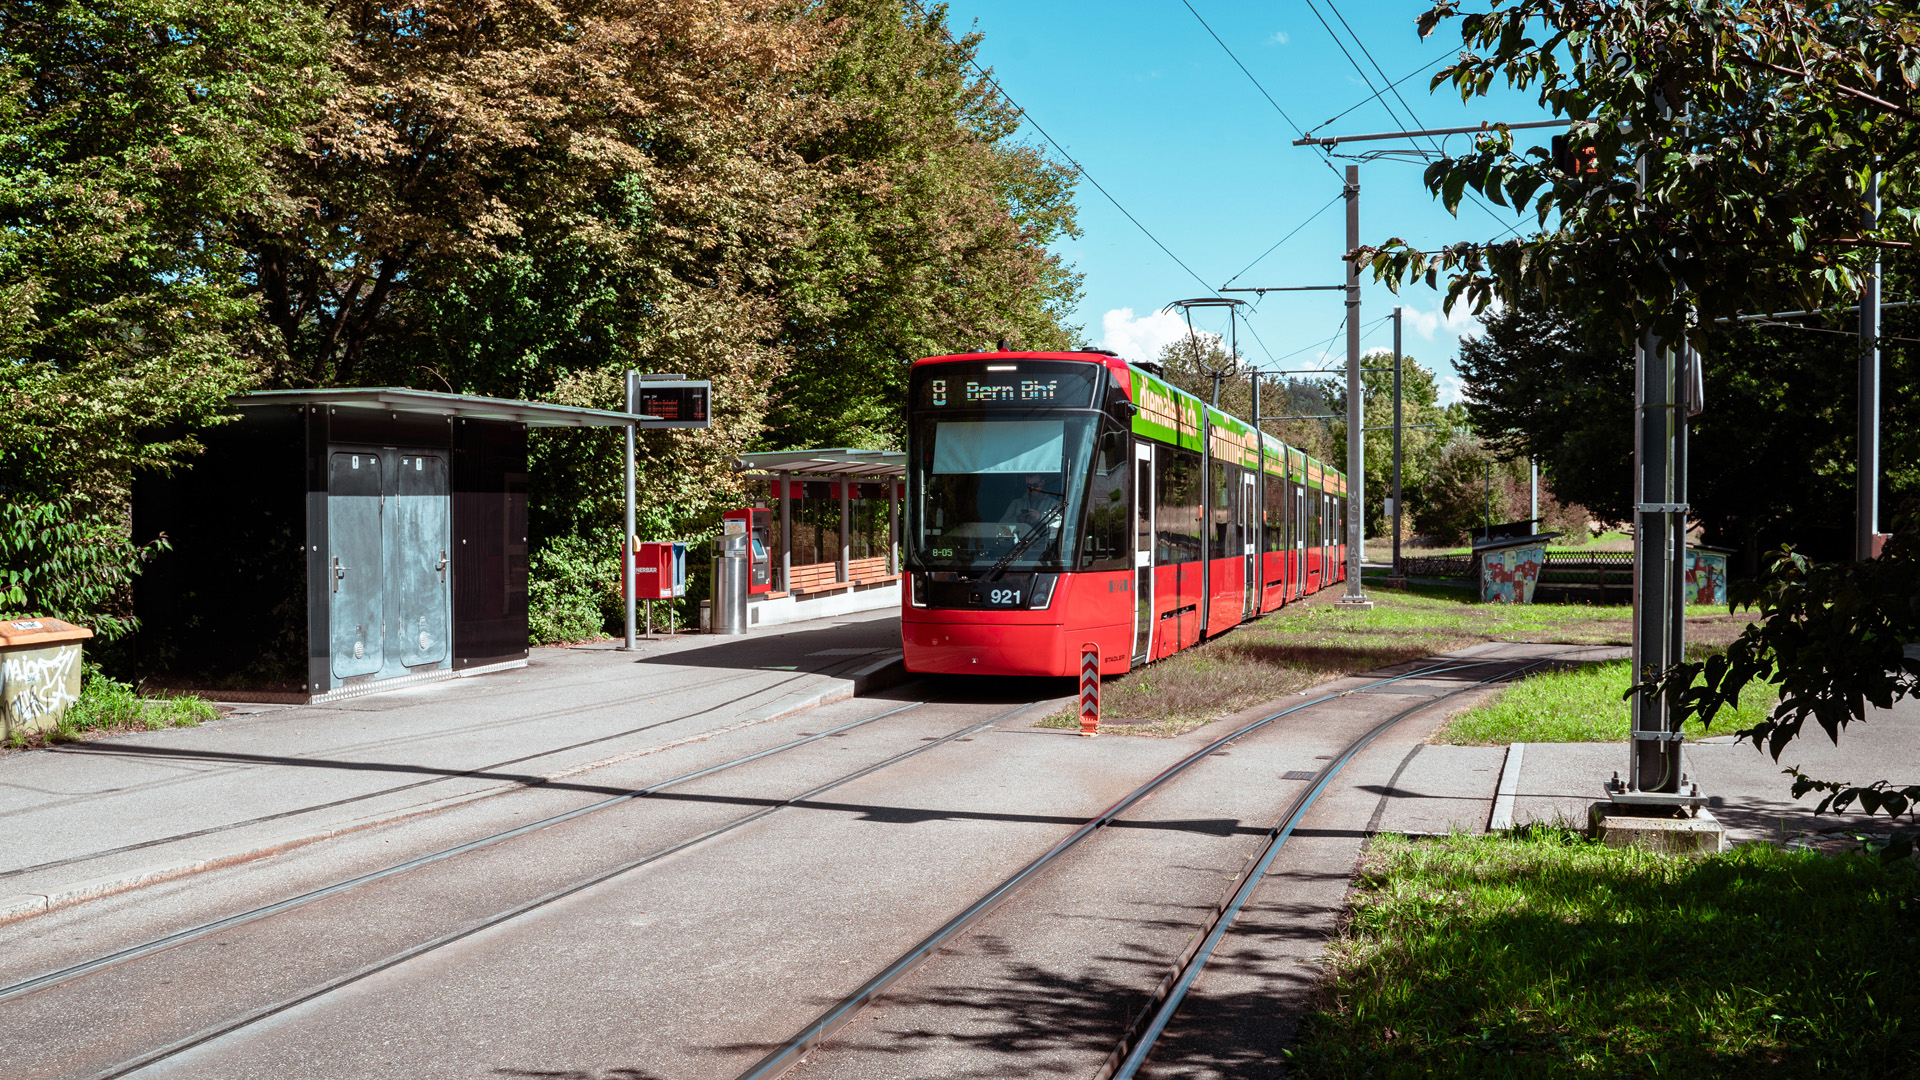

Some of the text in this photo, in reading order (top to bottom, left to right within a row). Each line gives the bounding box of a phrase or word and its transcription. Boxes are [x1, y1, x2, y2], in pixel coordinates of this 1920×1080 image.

[932, 379, 1058, 406] 8 Bern Bhf
[932, 548, 953, 557] 8-05
[991, 589, 1021, 604] 921
